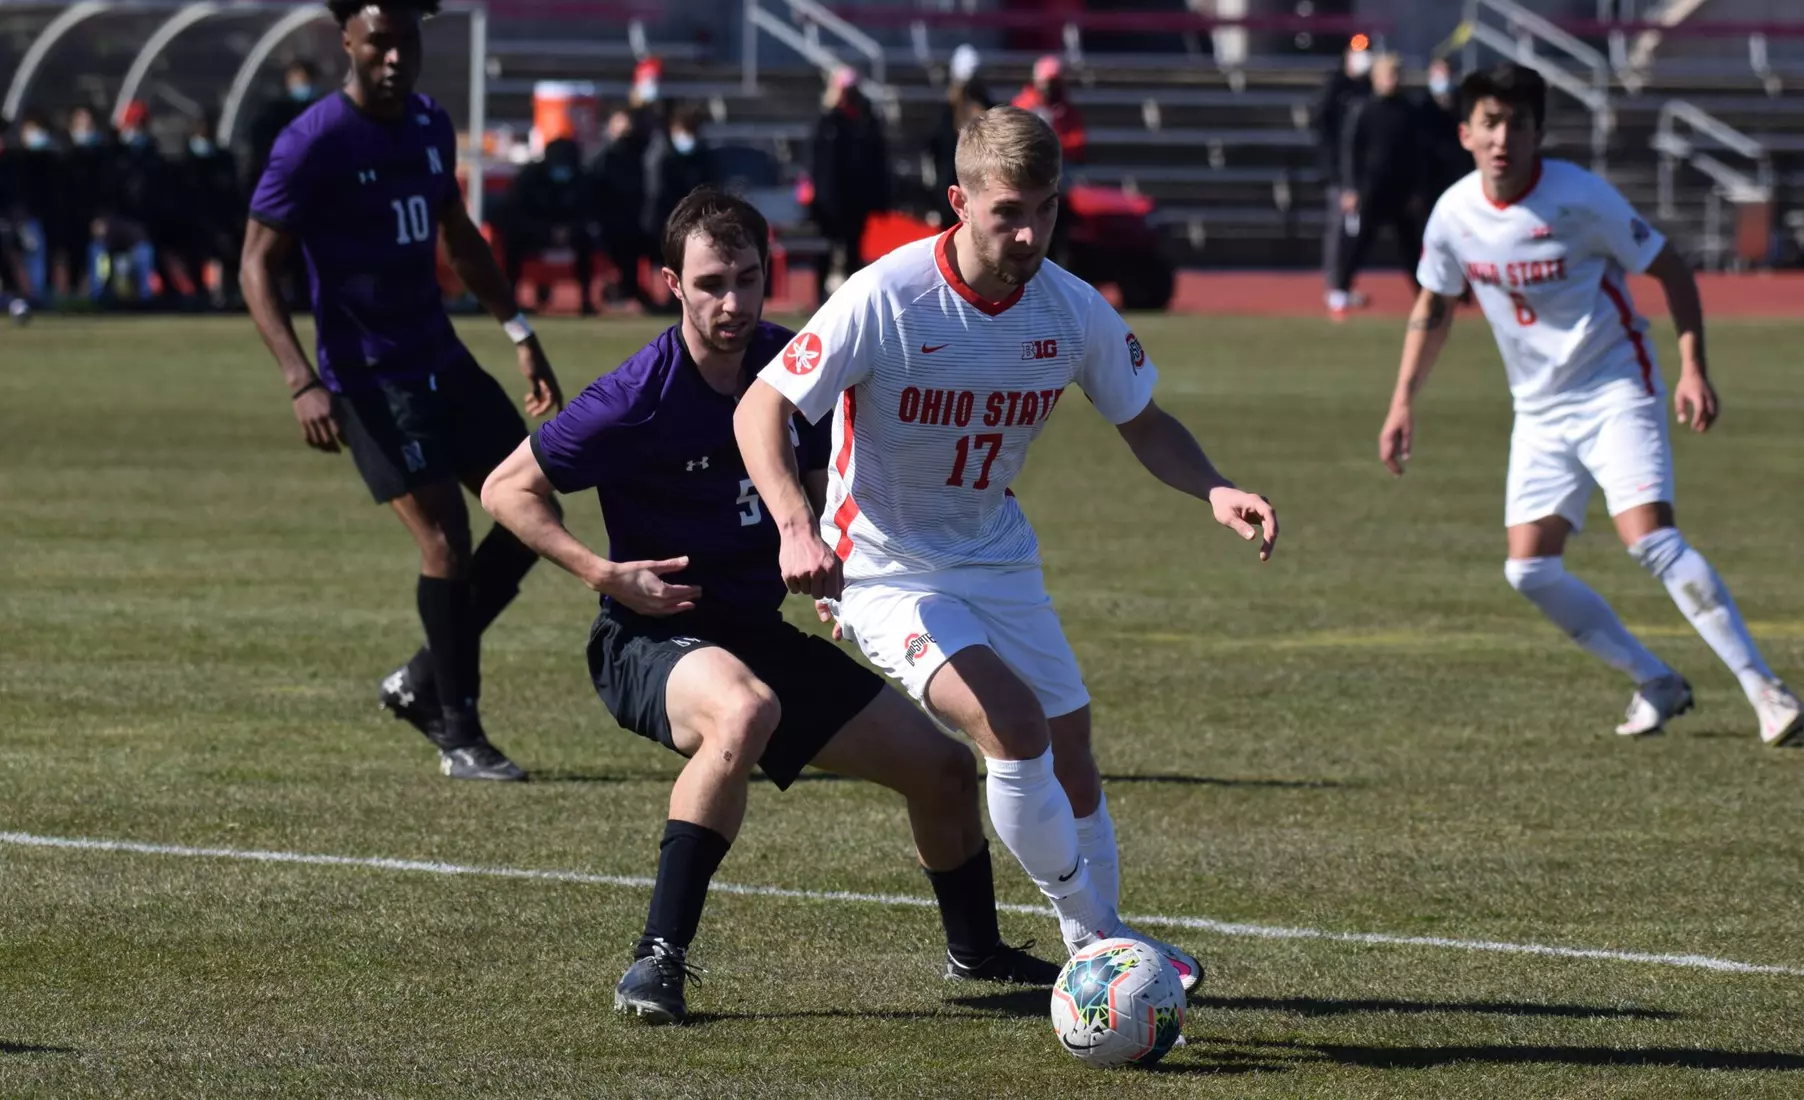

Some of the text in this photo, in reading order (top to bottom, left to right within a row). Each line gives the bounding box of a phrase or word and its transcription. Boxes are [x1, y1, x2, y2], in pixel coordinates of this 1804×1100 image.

[391, 195, 430, 245] 10
[1506, 257, 1567, 288] STATE
[898, 386, 975, 427] OHIO
[945, 433, 1004, 490] 17
[736, 478, 762, 527] 5
